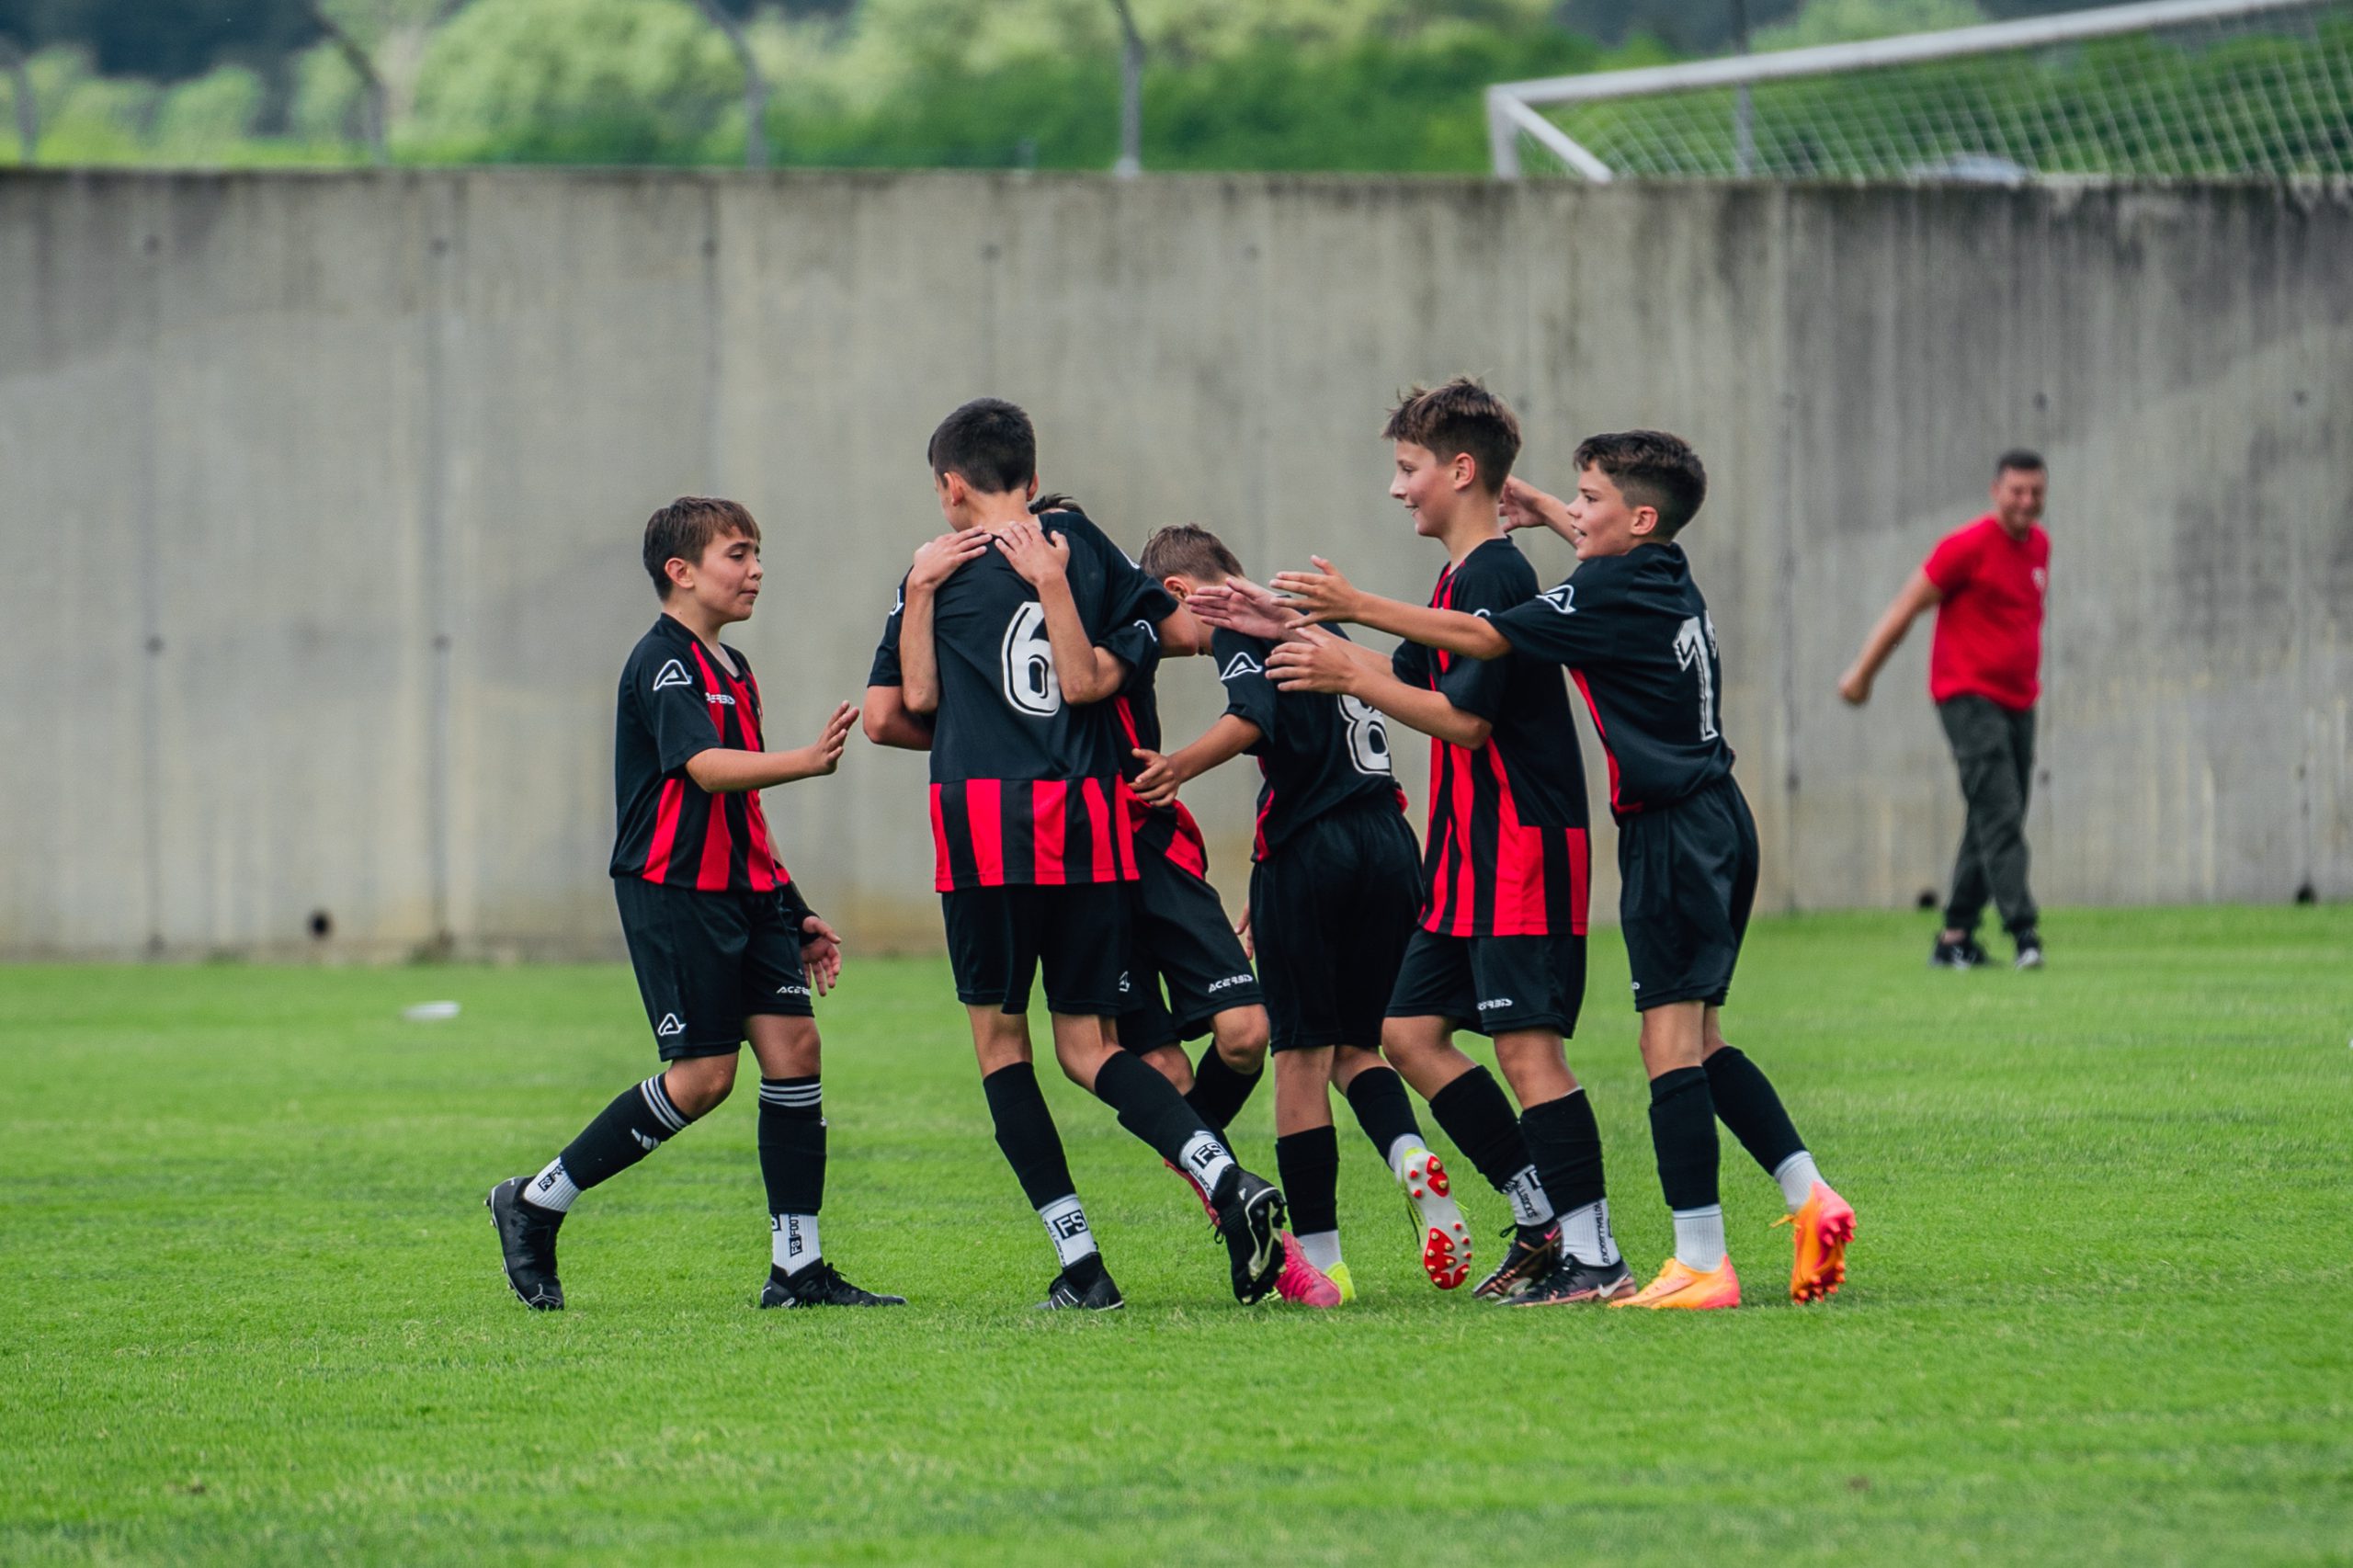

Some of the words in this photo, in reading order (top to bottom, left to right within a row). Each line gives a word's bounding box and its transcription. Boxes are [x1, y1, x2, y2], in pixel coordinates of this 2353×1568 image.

[1001, 600, 1062, 717] 6
[1337, 694, 1392, 777] 8
[1194, 1142, 1225, 1165] FS
[1055, 1211, 1087, 1237] FS
